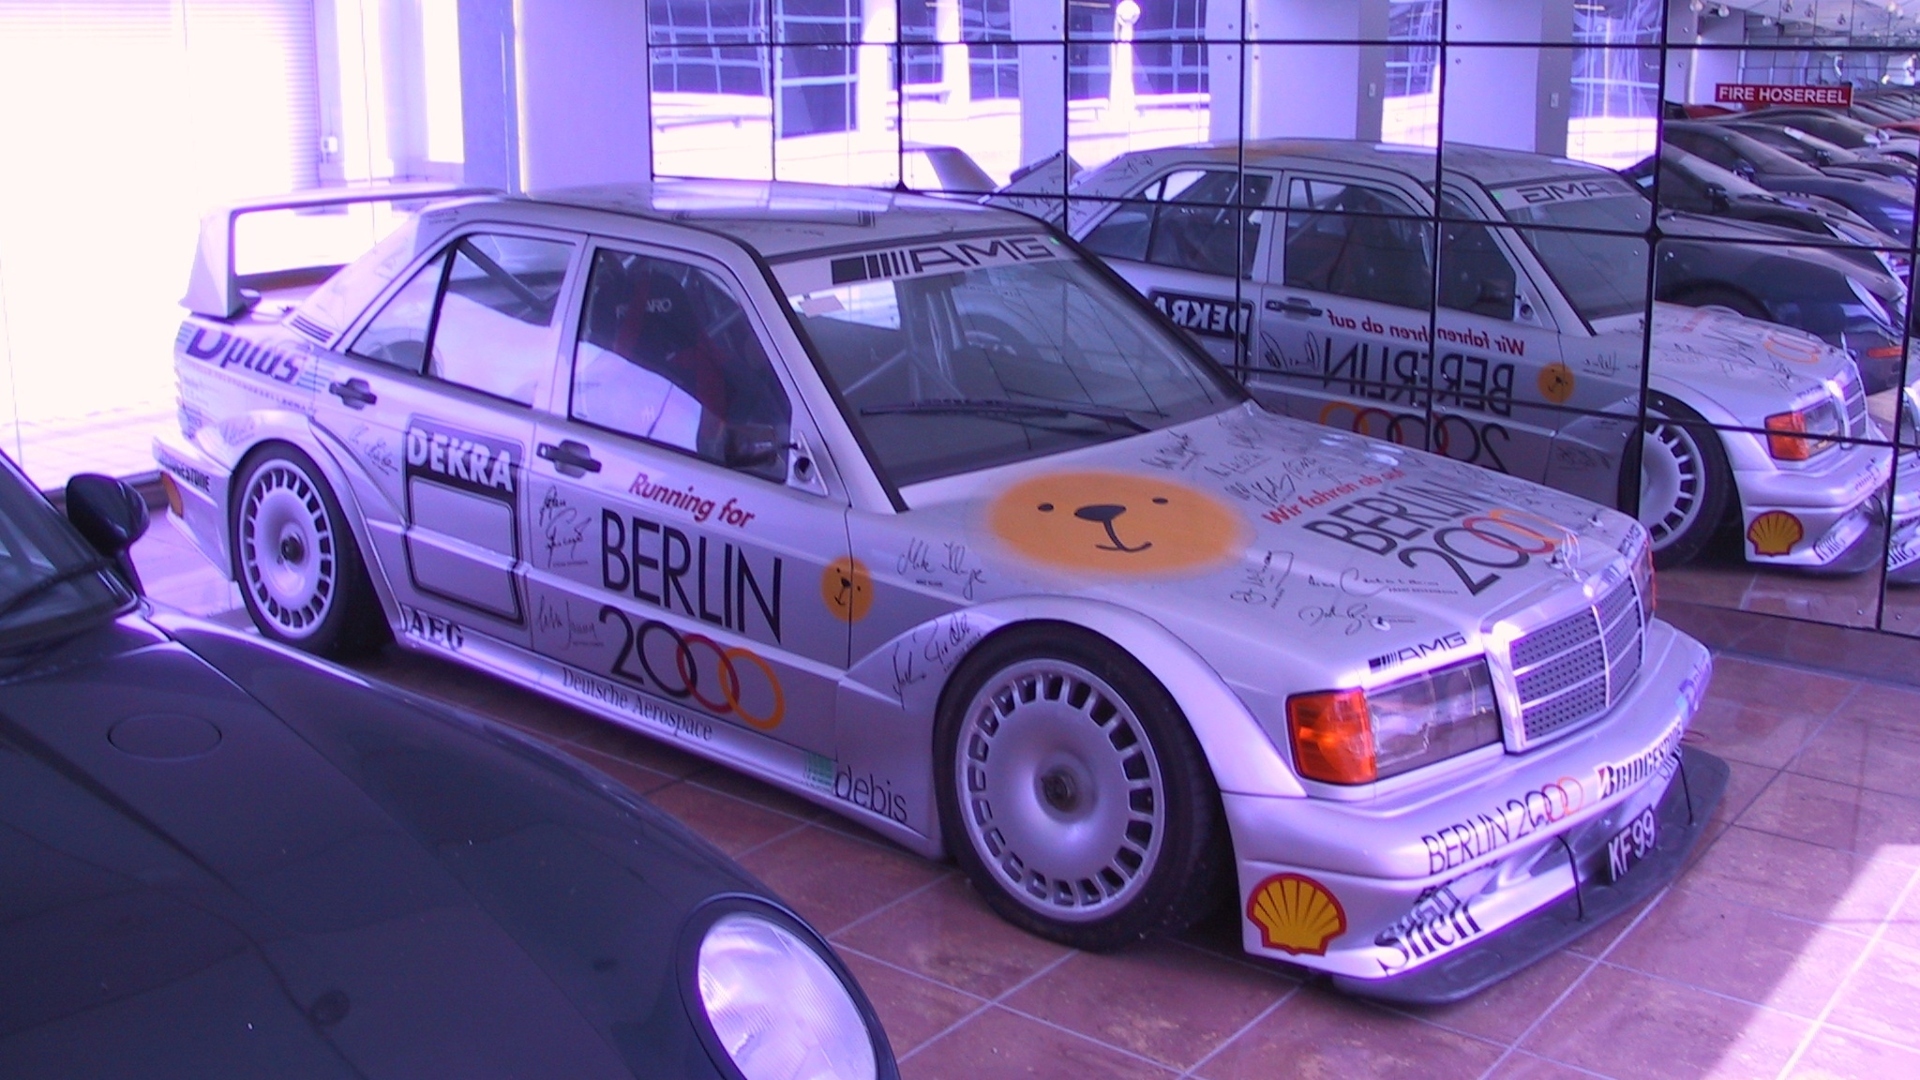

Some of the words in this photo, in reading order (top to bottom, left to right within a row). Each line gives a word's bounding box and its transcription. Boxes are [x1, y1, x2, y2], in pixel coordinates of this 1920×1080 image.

[1718, 86, 1755, 101] FIRE
[1758, 88, 1848, 104] HOSEREEL
[908, 237, 1056, 274] AMG
[407, 427, 514, 493] DEKRA
[628, 471, 716, 523] Running
[718, 497, 756, 528] for
[1261, 502, 1303, 525] Wir
[1298, 480, 1361, 509] fahren
[1358, 473, 1384, 487] ab
[1303, 479, 1503, 556] BERLIN
[602, 508, 783, 645] BERLIN
[1398, 508, 1578, 597] 2000
[411, 610, 465, 652] AEG
[599, 604, 785, 731] 2000
[562, 667, 629, 709] Deutsche
[632, 695, 714, 742] Aerospace
[835, 764, 908, 823] debis
[1421, 806, 1510, 876] BERLIN
